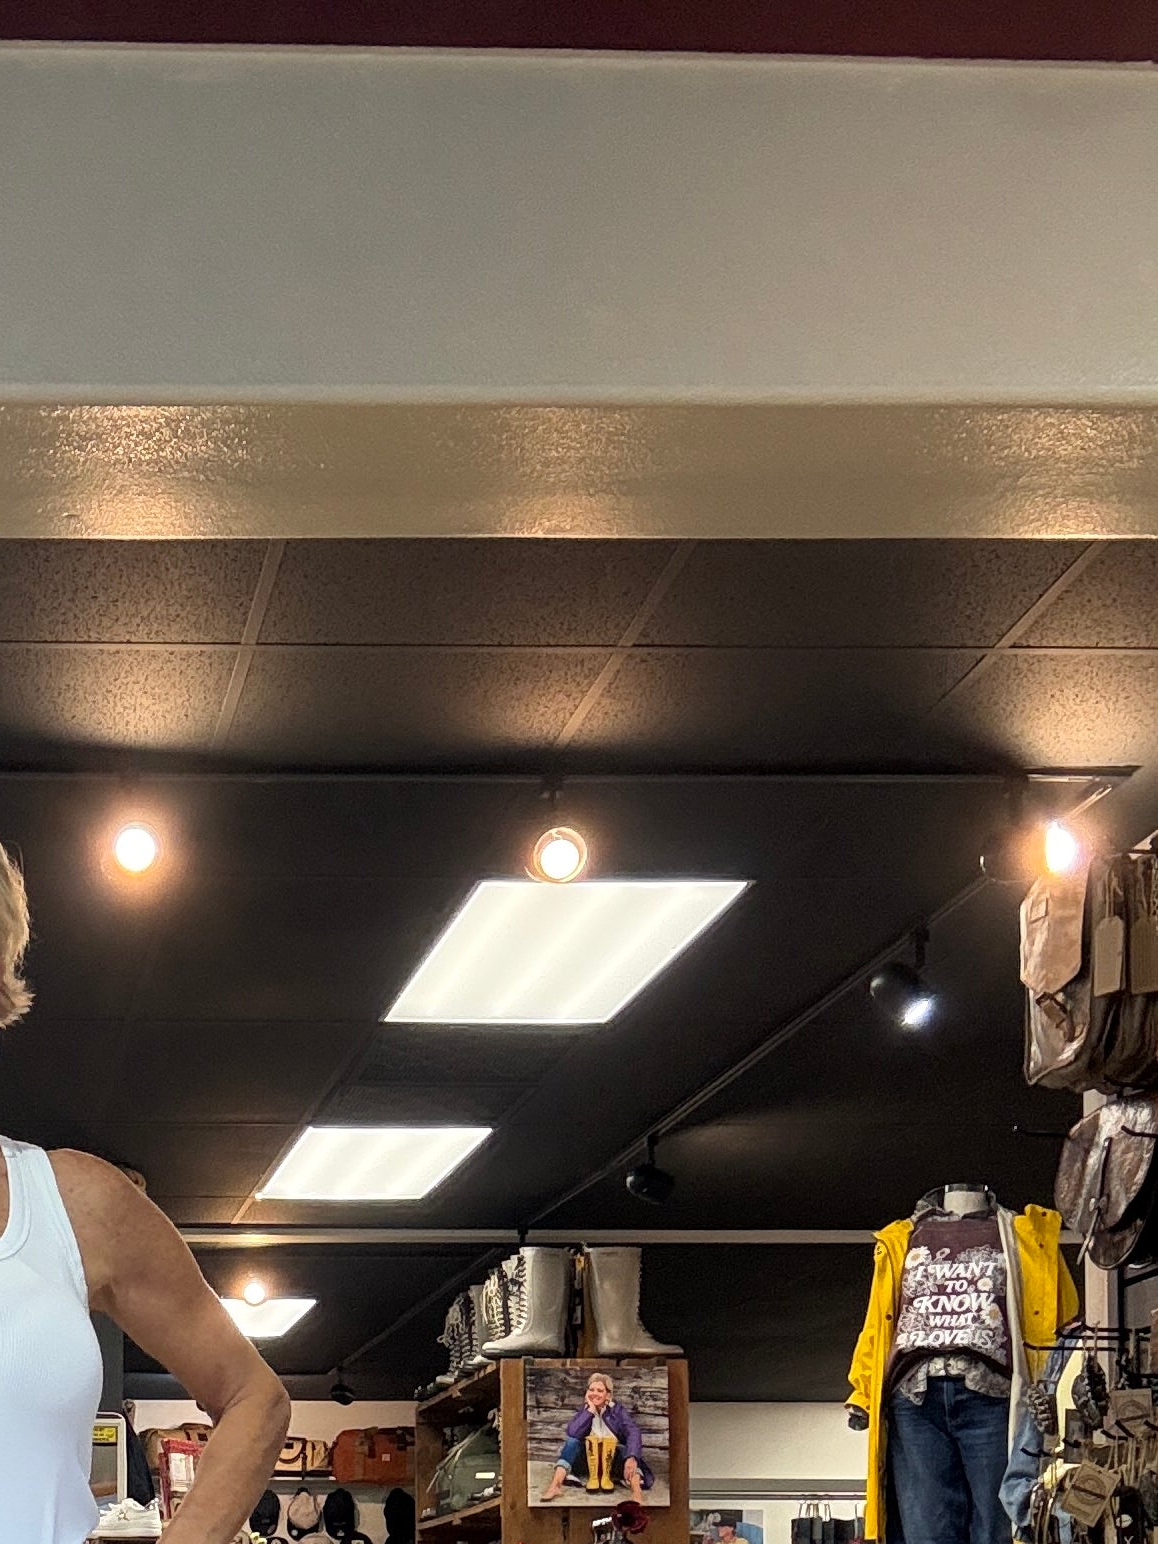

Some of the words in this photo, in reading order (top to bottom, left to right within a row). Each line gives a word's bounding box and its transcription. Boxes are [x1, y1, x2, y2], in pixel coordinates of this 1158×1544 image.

[928, 1262, 996, 1279] WANT
[944, 1280, 968, 1292] TO
[913, 1293, 995, 1313] KNOW
[929, 1313, 973, 1327] WHAT
[909, 1329, 973, 1346] LOVE
